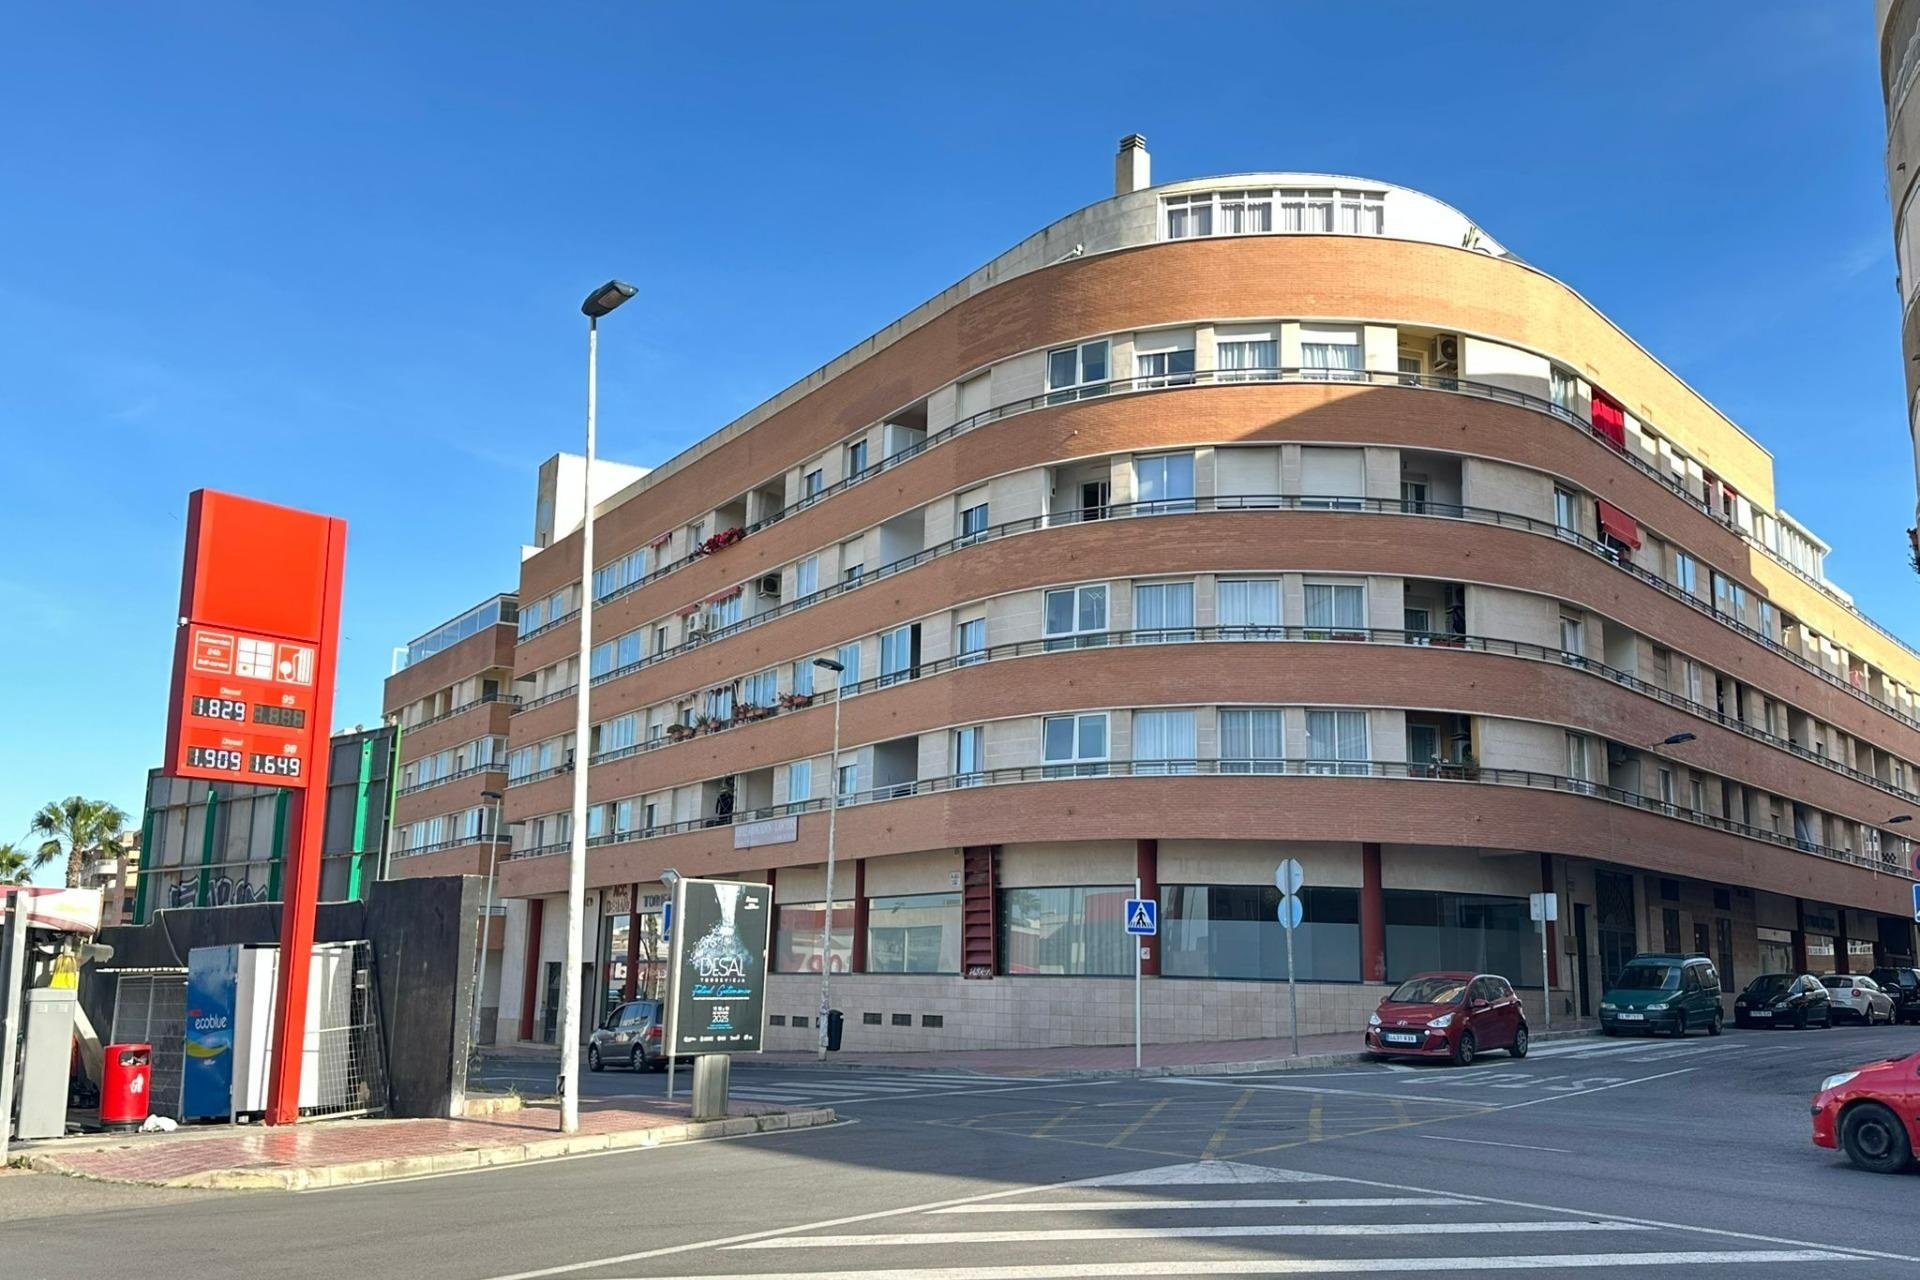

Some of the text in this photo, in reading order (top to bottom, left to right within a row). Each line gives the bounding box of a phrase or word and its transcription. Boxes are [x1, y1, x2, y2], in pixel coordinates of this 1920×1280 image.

[197, 698, 246, 721] 1.829
[282, 695, 295, 705] 95
[193, 748, 242, 771] 1.909
[254, 754, 300, 777] 1.649
[700, 957, 746, 977] DESAL
[195, 1013, 227, 1029] ecoblue
[711, 1014, 730, 1023] 2025
